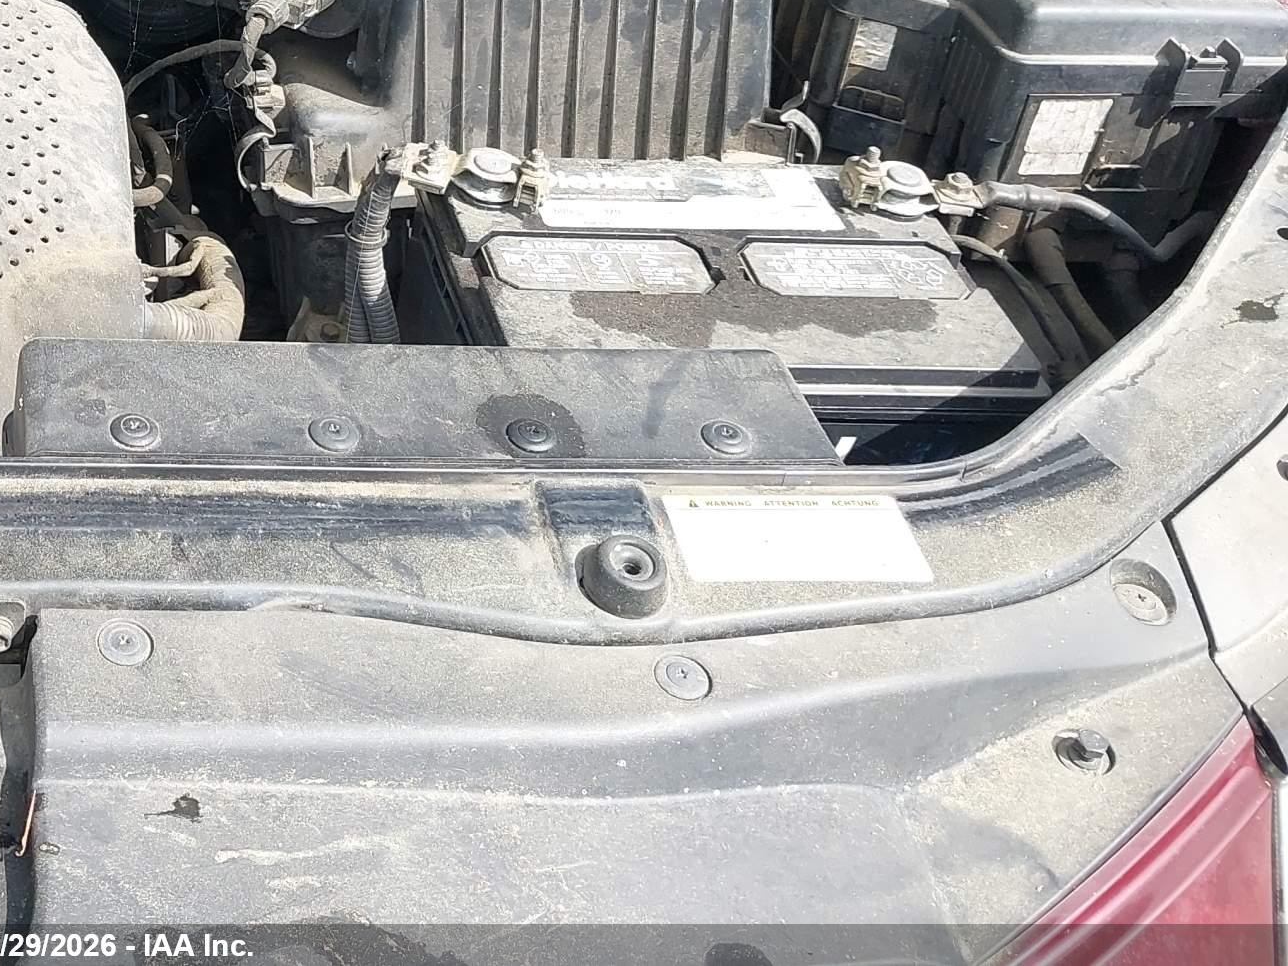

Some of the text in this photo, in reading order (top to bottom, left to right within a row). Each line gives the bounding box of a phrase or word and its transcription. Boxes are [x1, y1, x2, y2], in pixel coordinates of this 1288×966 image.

[704, 499, 880, 508] WARNING ATTENTION ACHTUNG
